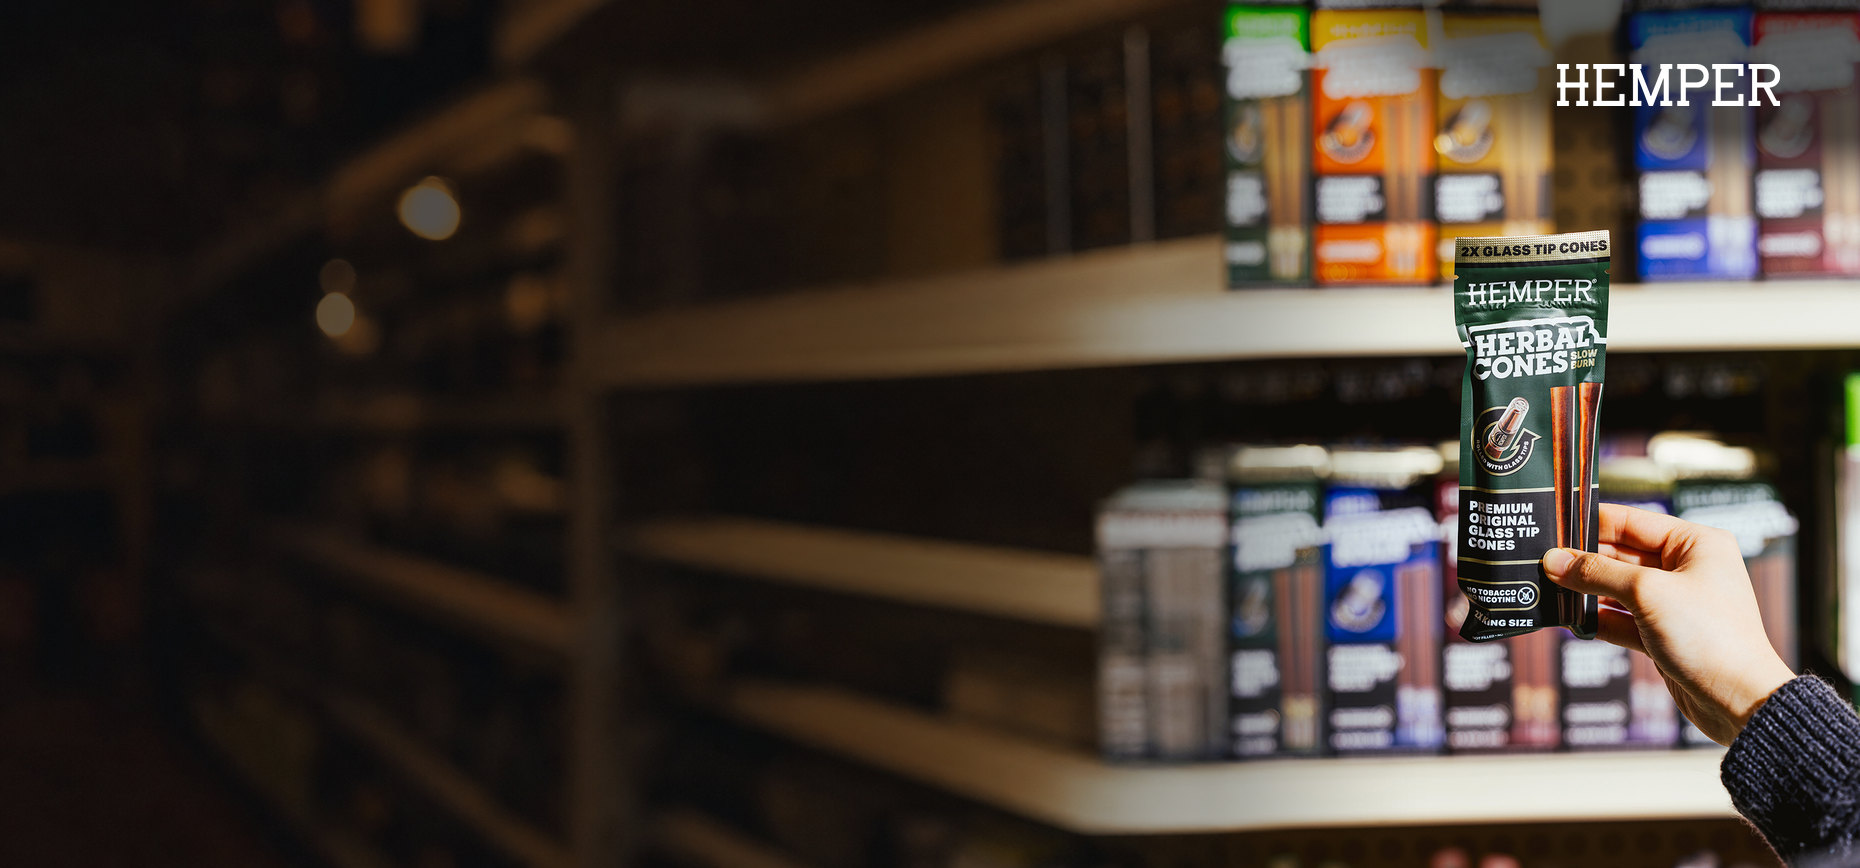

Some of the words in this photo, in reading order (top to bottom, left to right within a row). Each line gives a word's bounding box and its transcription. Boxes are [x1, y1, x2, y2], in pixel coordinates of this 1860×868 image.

[1461, 246, 1480, 257] 2X
[1482, 245, 1531, 257] GLASS
[1534, 243, 1557, 255] TIP
[1559, 239, 1608, 253] CONES
[1474, 324, 1590, 358] HERBAL
[1570, 348, 1598, 361] SLOW
[1473, 350, 1569, 381] CONES
[1570, 357, 1596, 370] BURN
[1486, 461, 1503, 471] WITH
[1503, 455, 1523, 470] GLASS
[1521, 440, 1530, 456] TIPS
[1469, 500, 1533, 514] PREMIUM
[1469, 512, 1536, 527] ORIGINAL
[1468, 525, 1514, 539] GLASS
[1516, 526, 1540, 538] TIP
[1468, 537, 1515, 551] CONES
[1478, 588, 1516, 597] TOBACCO
[1478, 595, 1516, 603] NICOTINE
[1508, 619, 1533, 627] SIZE
